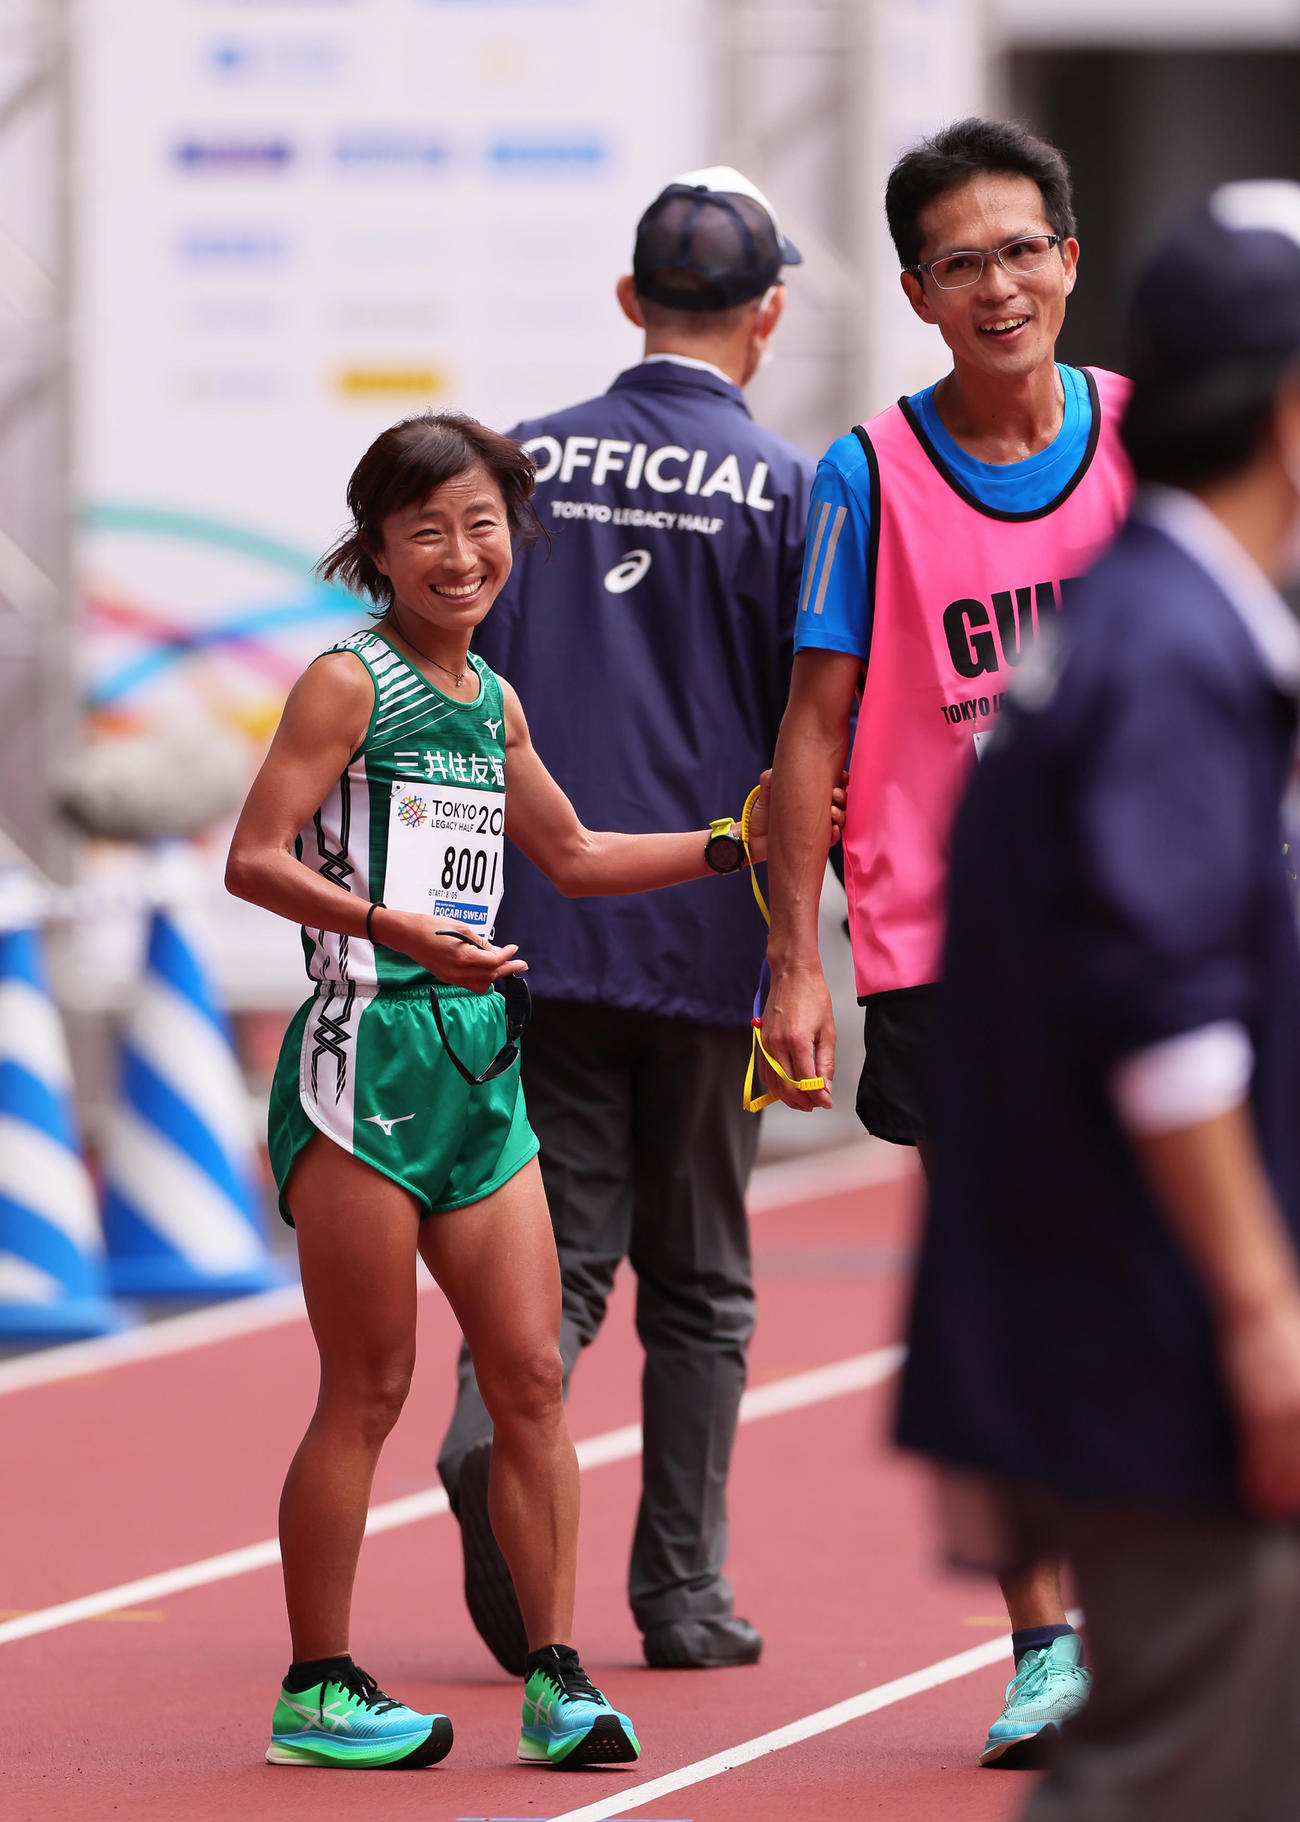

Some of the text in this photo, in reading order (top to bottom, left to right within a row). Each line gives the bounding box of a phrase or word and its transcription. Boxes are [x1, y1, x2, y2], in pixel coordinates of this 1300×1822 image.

[524, 435, 775, 512] OFFICIAL
[552, 501, 723, 535] TOKYO LEGACY HALF
[941, 697, 990, 725] TOKYO
[431, 819, 474, 833] LEGACY HALF
[432, 800, 505, 836] TOKYO 20
[441, 846, 498, 895] 8001
[434, 906, 487, 922] POCARI SWEAT
